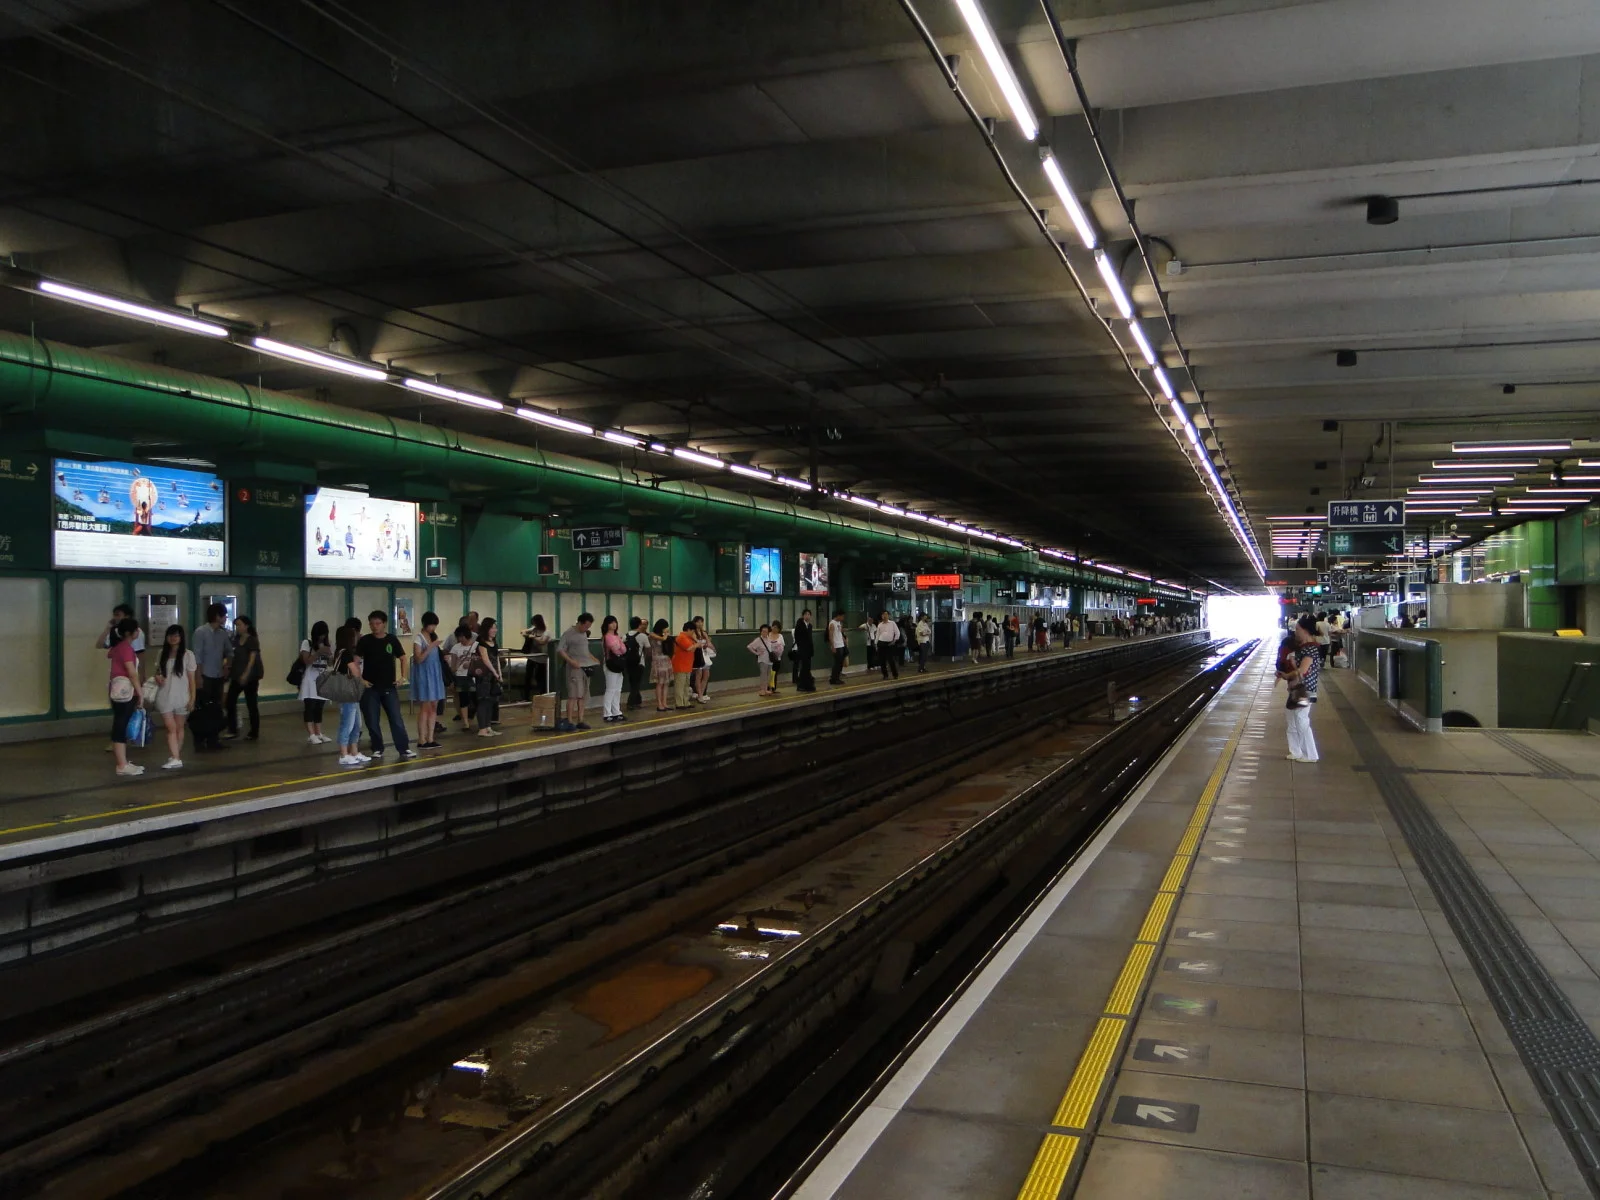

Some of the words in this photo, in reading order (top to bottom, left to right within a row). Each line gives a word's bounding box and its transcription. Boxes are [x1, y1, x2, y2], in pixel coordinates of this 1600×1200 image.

[1333, 505, 1359, 515] 升降機
[1335, 535, 1349, 547] 出
